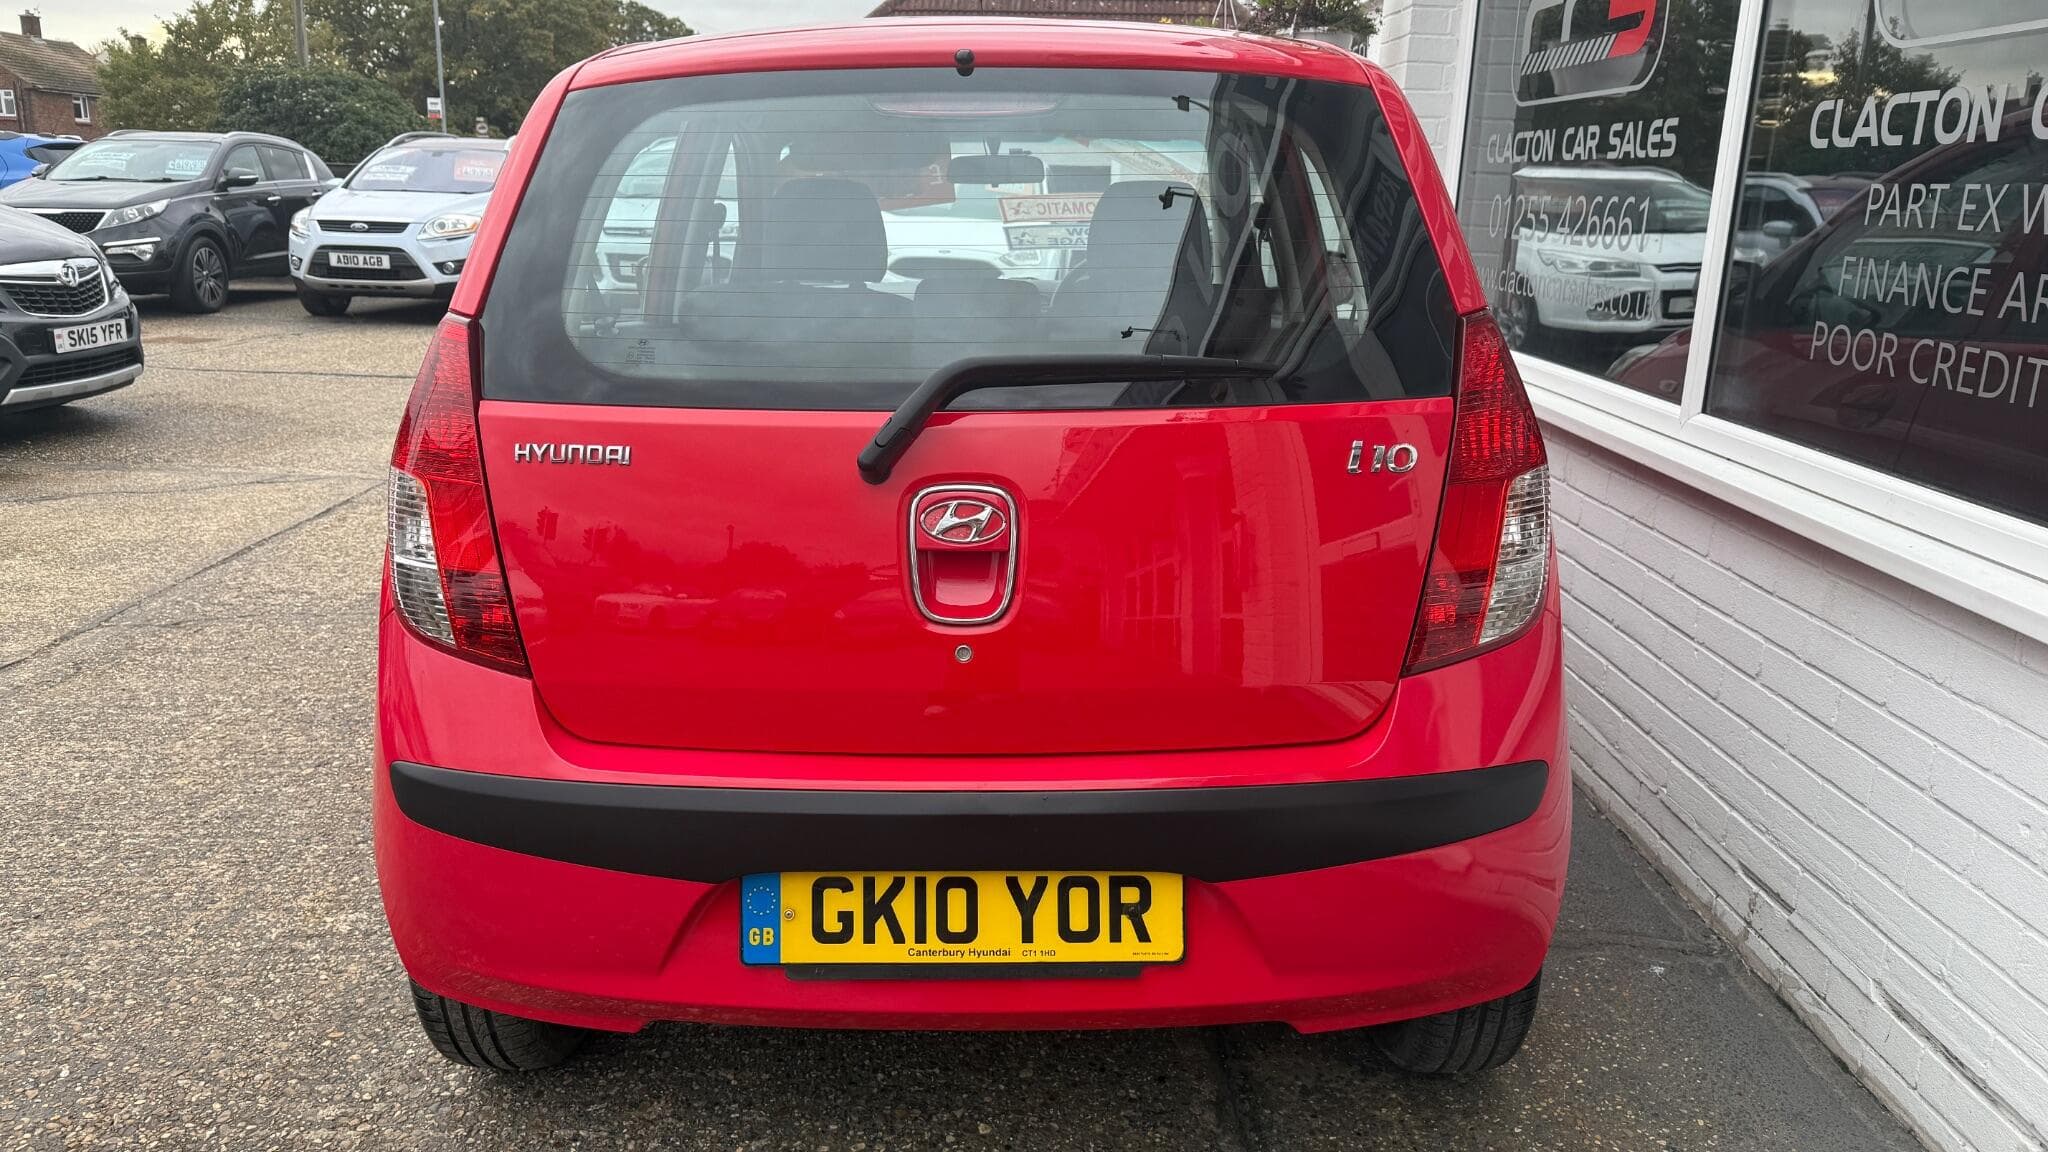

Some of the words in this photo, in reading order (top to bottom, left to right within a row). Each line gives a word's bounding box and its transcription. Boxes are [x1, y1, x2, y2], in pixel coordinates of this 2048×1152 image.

[1487, 129, 1557, 164] CLACTON
[1562, 125, 1600, 160] CAR
[1606, 117, 1680, 160] SALES
[1810, 83, 2008, 149] CLACTON
[1489, 194, 1551, 243] 01255
[1556, 195, 1650, 253] 426661
[1864, 183, 1950, 230] PART
[1957, 183, 2010, 233] EX
[1838, 256, 1992, 316] FINANCE
[67, 327, 98, 347] SK15
[100, 322, 123, 342] YFR
[1810, 320, 1899, 378] POOR
[1909, 338, 2048, 408] CREDIT
[514, 443, 632, 465] HYUNDAI
[749, 927, 775, 946] GB
[811, 876, 979, 944] GK10
[1005, 875, 1152, 944] YOR
[907, 948, 966, 959] Canterbury
[968, 947, 1011, 959] Hyundai
